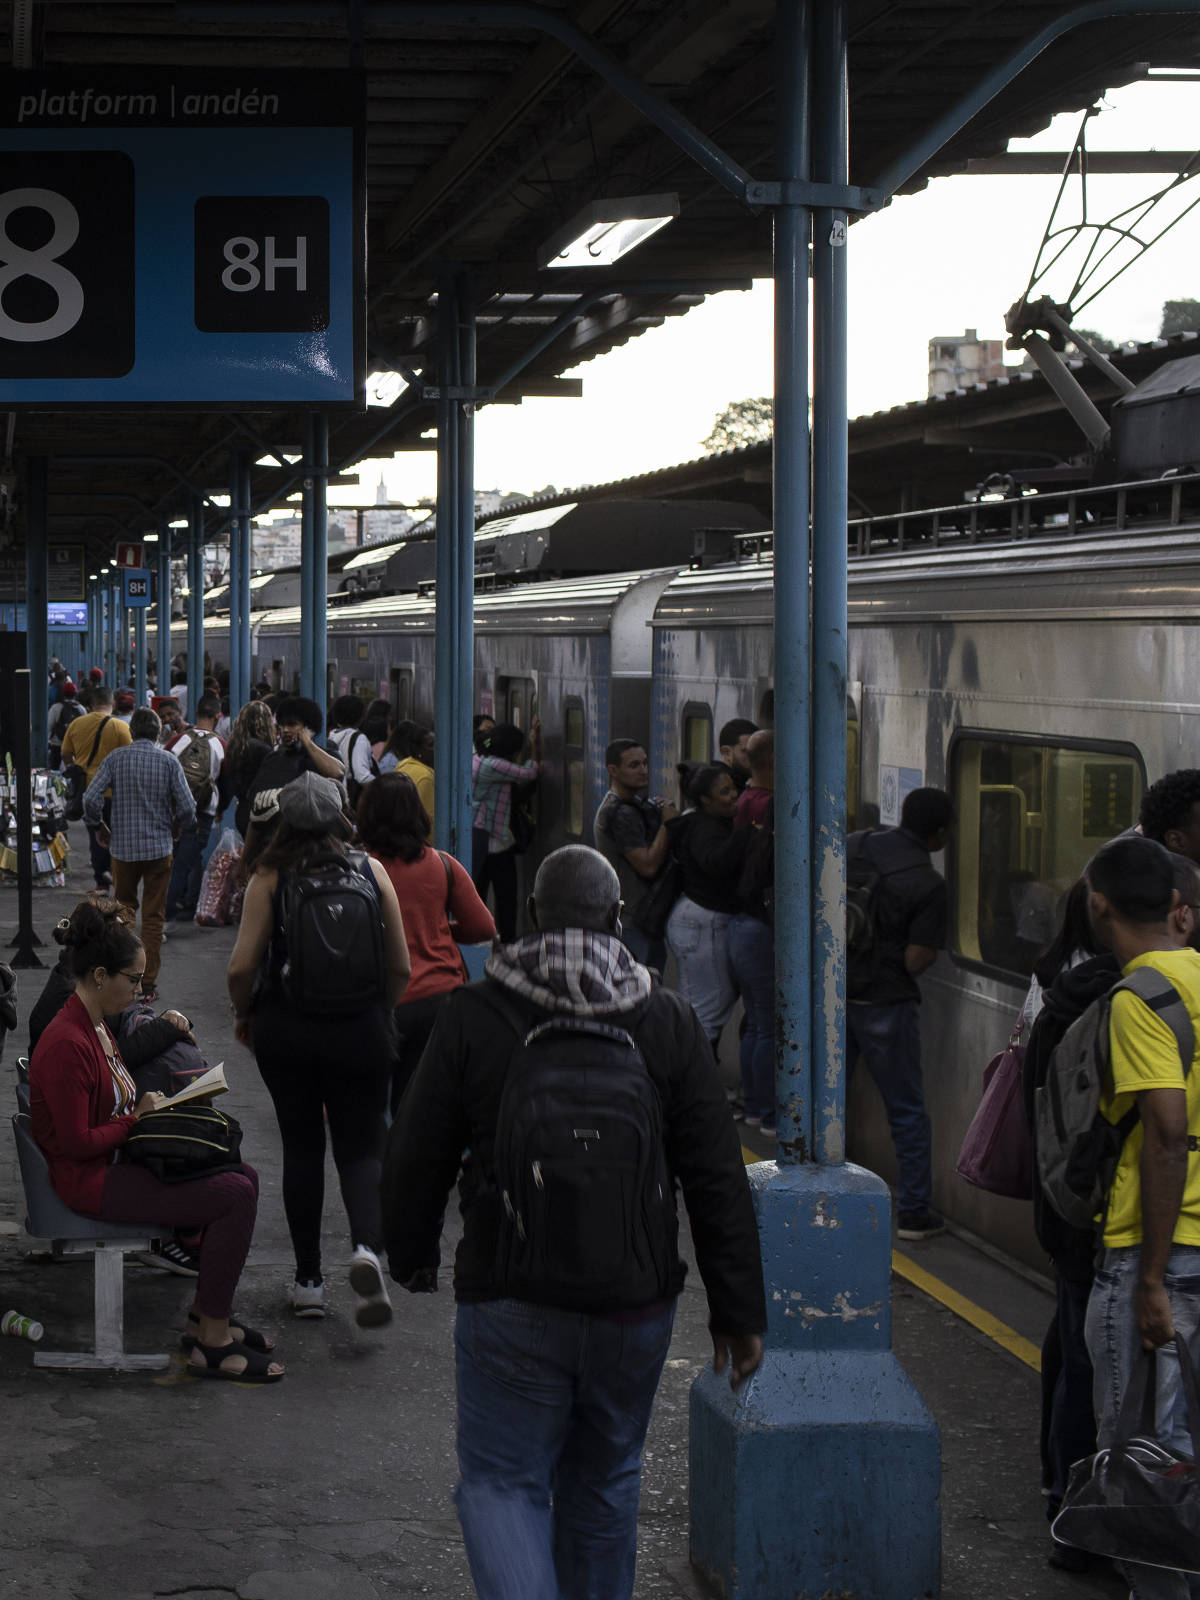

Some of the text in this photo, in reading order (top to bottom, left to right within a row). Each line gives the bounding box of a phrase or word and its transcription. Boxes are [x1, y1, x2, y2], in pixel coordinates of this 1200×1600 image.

[18, 88, 156, 122] platform
[182, 87, 279, 115] andén
[221, 236, 307, 292] 8H
[129, 582, 146, 593] 8H
[253, 788, 282, 811] NIK
